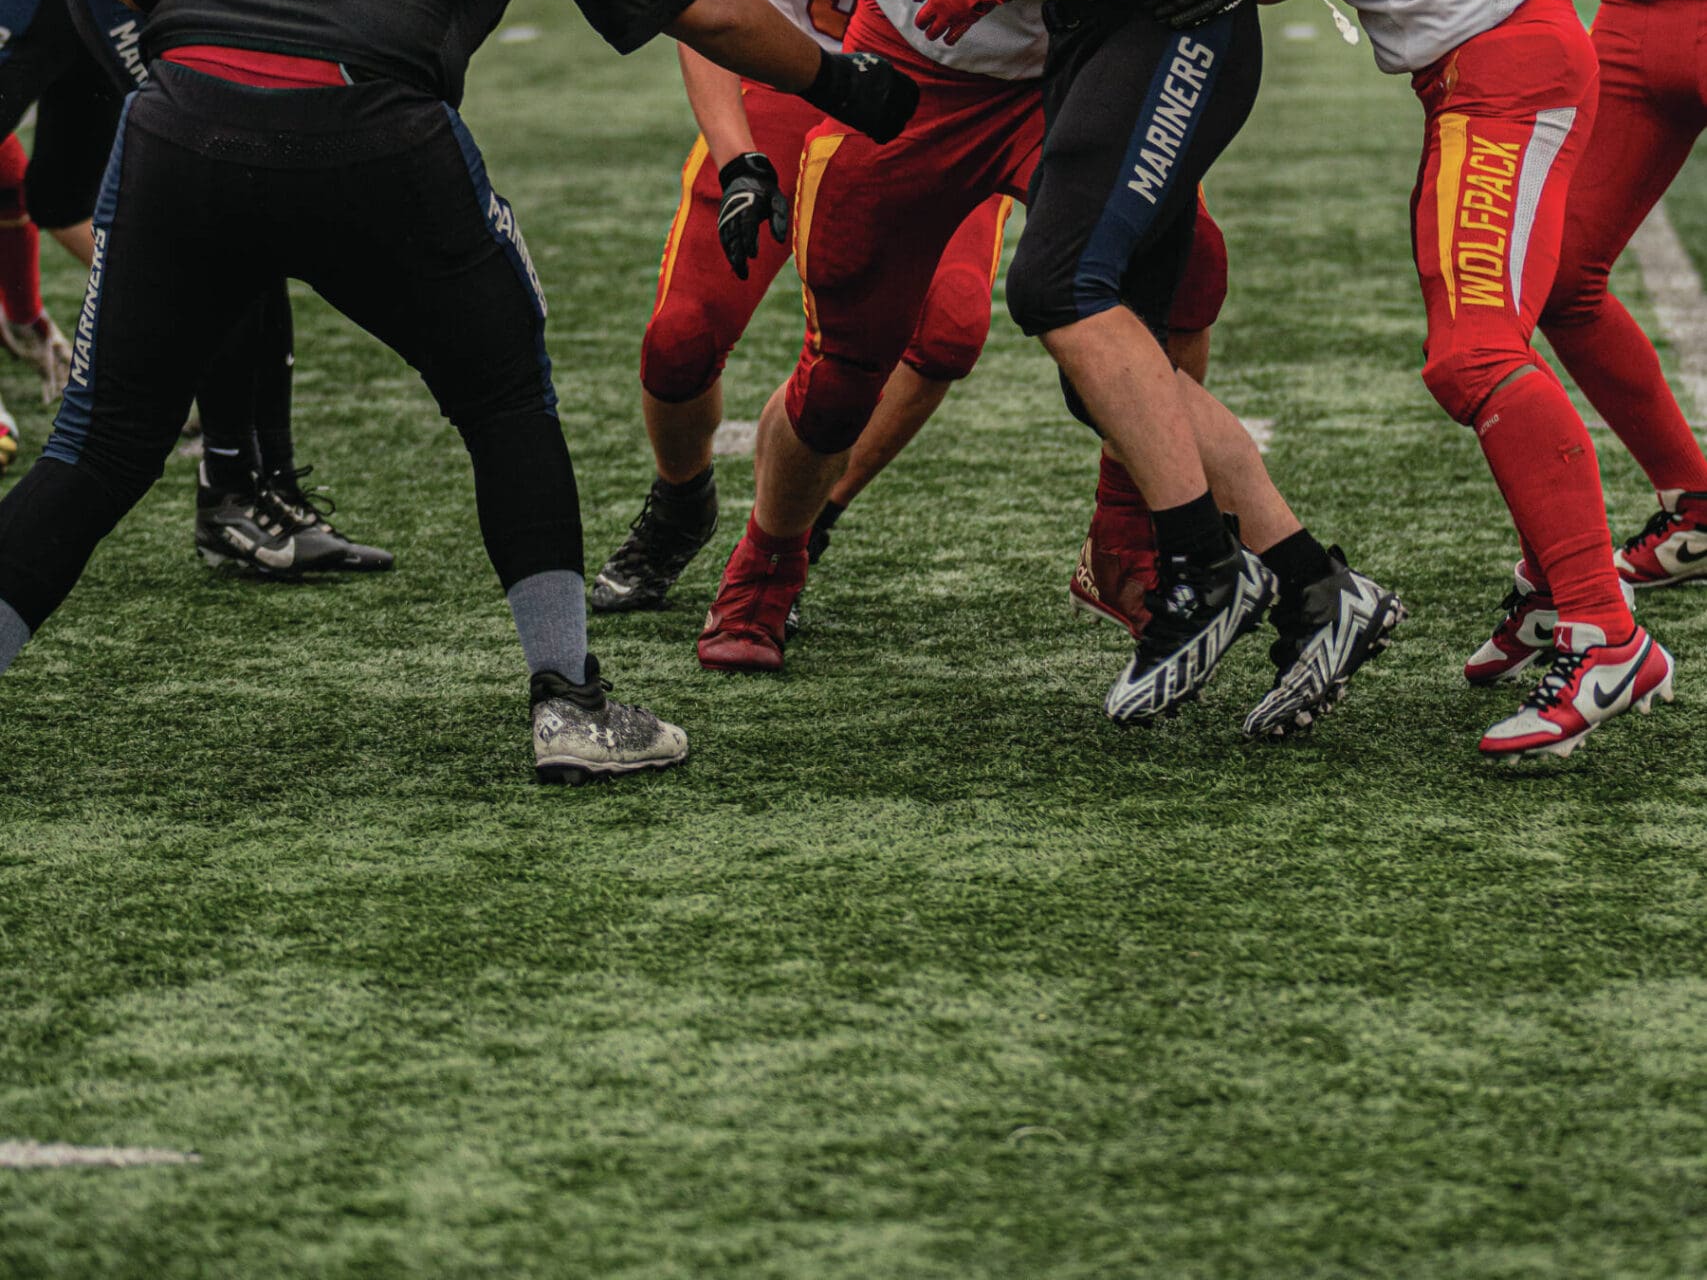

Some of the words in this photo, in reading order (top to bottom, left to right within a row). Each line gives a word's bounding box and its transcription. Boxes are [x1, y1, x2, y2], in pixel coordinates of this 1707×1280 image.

[1127, 35, 1215, 204] MARINERS
[1460, 134, 1521, 309] WOLFPACK
[71, 227, 107, 389] MARINERS
